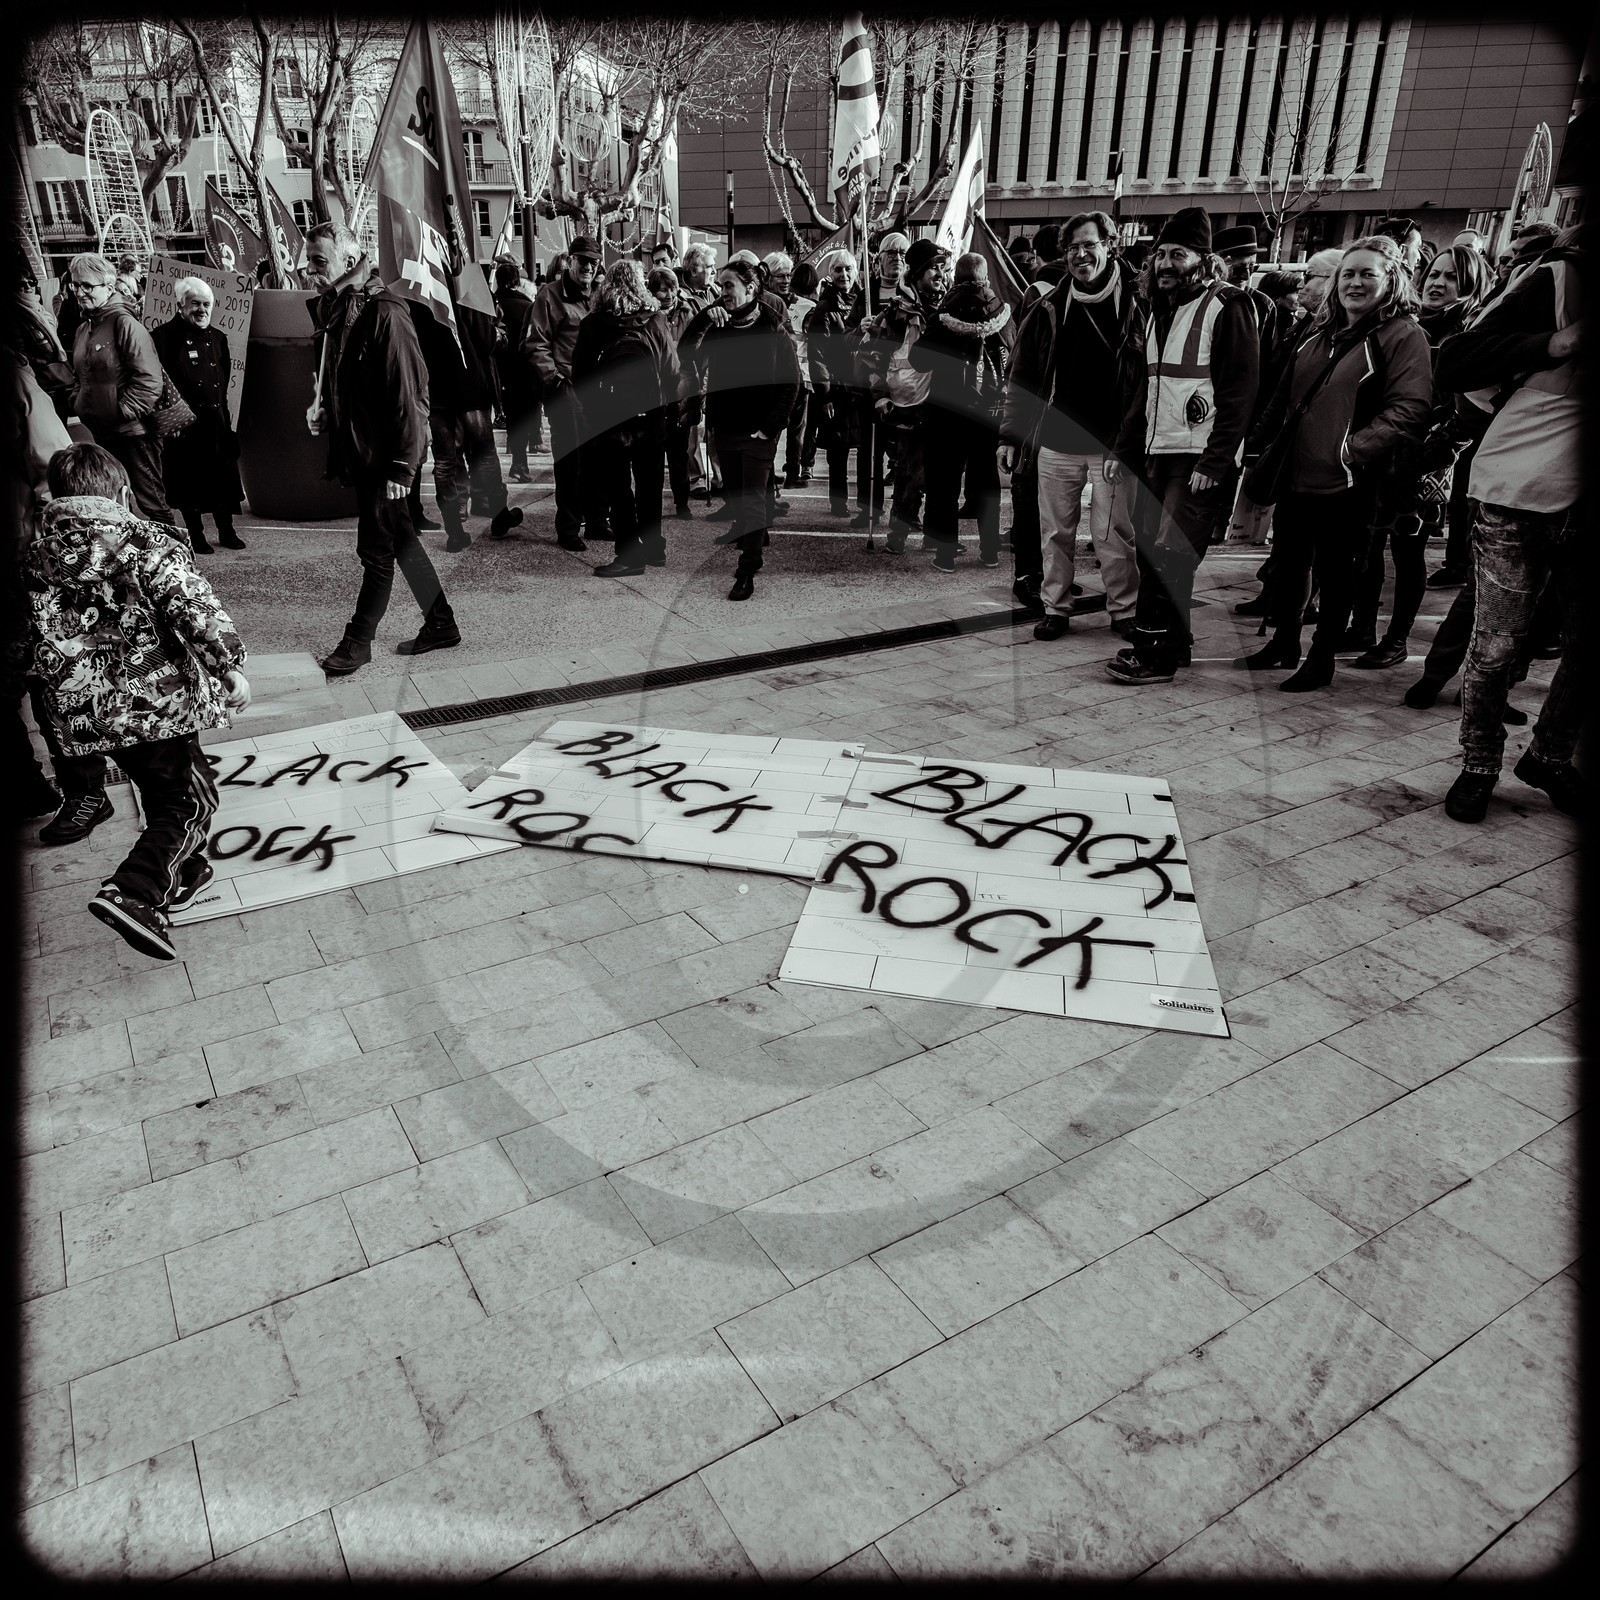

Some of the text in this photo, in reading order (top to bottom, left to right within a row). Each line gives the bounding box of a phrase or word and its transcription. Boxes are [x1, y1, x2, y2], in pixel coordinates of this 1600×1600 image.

[149, 257, 165, 276] LA
[206, 276, 226, 289] POUR
[224, 295, 251, 315] 2019
[554, 731, 773, 834] BLACK
[204, 824, 357, 872] OCK
[870, 765, 1189, 912] BLACK
[818, 840, 1156, 990] ROCK
[1158, 998, 1215, 1014] Solidaires
